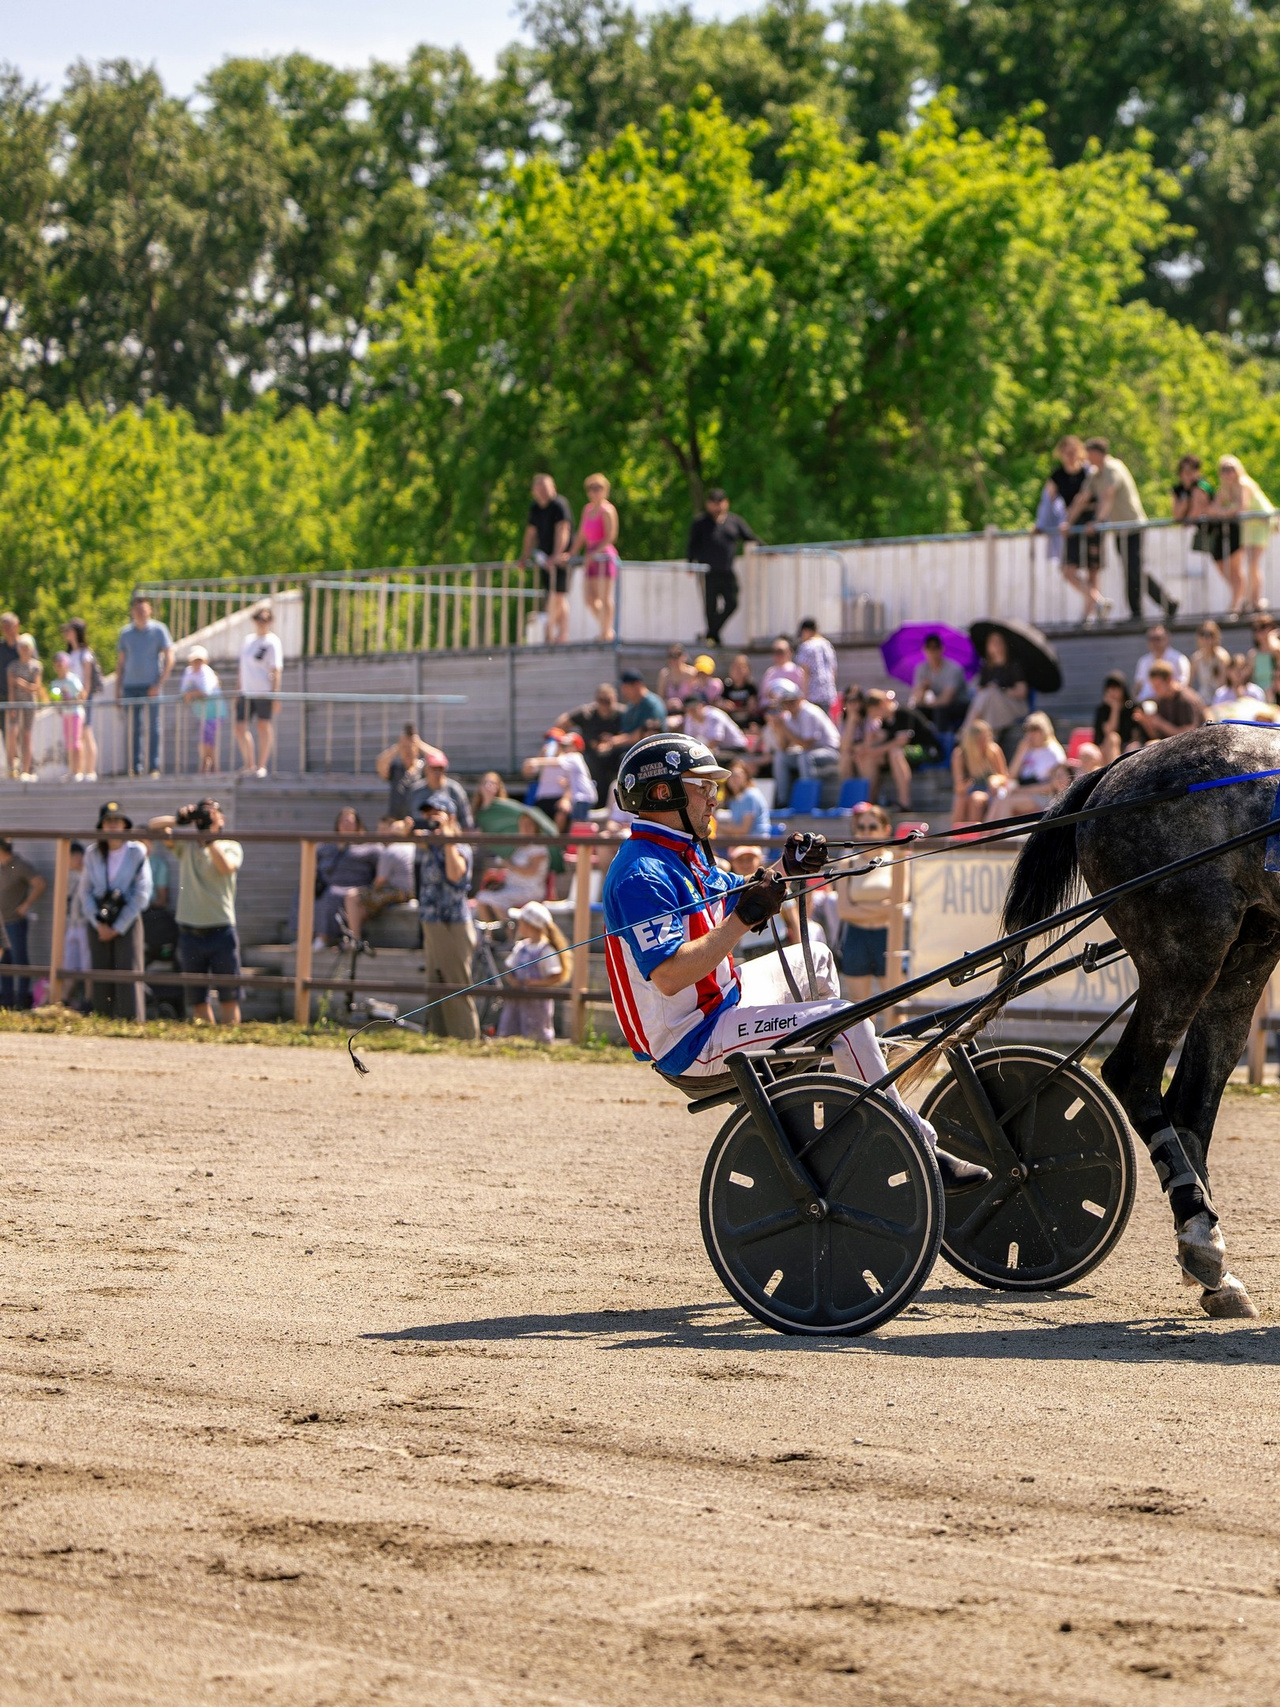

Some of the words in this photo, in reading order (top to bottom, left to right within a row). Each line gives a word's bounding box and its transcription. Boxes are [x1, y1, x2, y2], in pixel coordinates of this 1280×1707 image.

[637, 767, 668, 780] ZAIFERT
[640, 761, 664, 773] EVALD
[632, 914, 683, 952] EZ
[738, 1023, 749, 1037] E.
[754, 1014, 798, 1034] Zaifert
